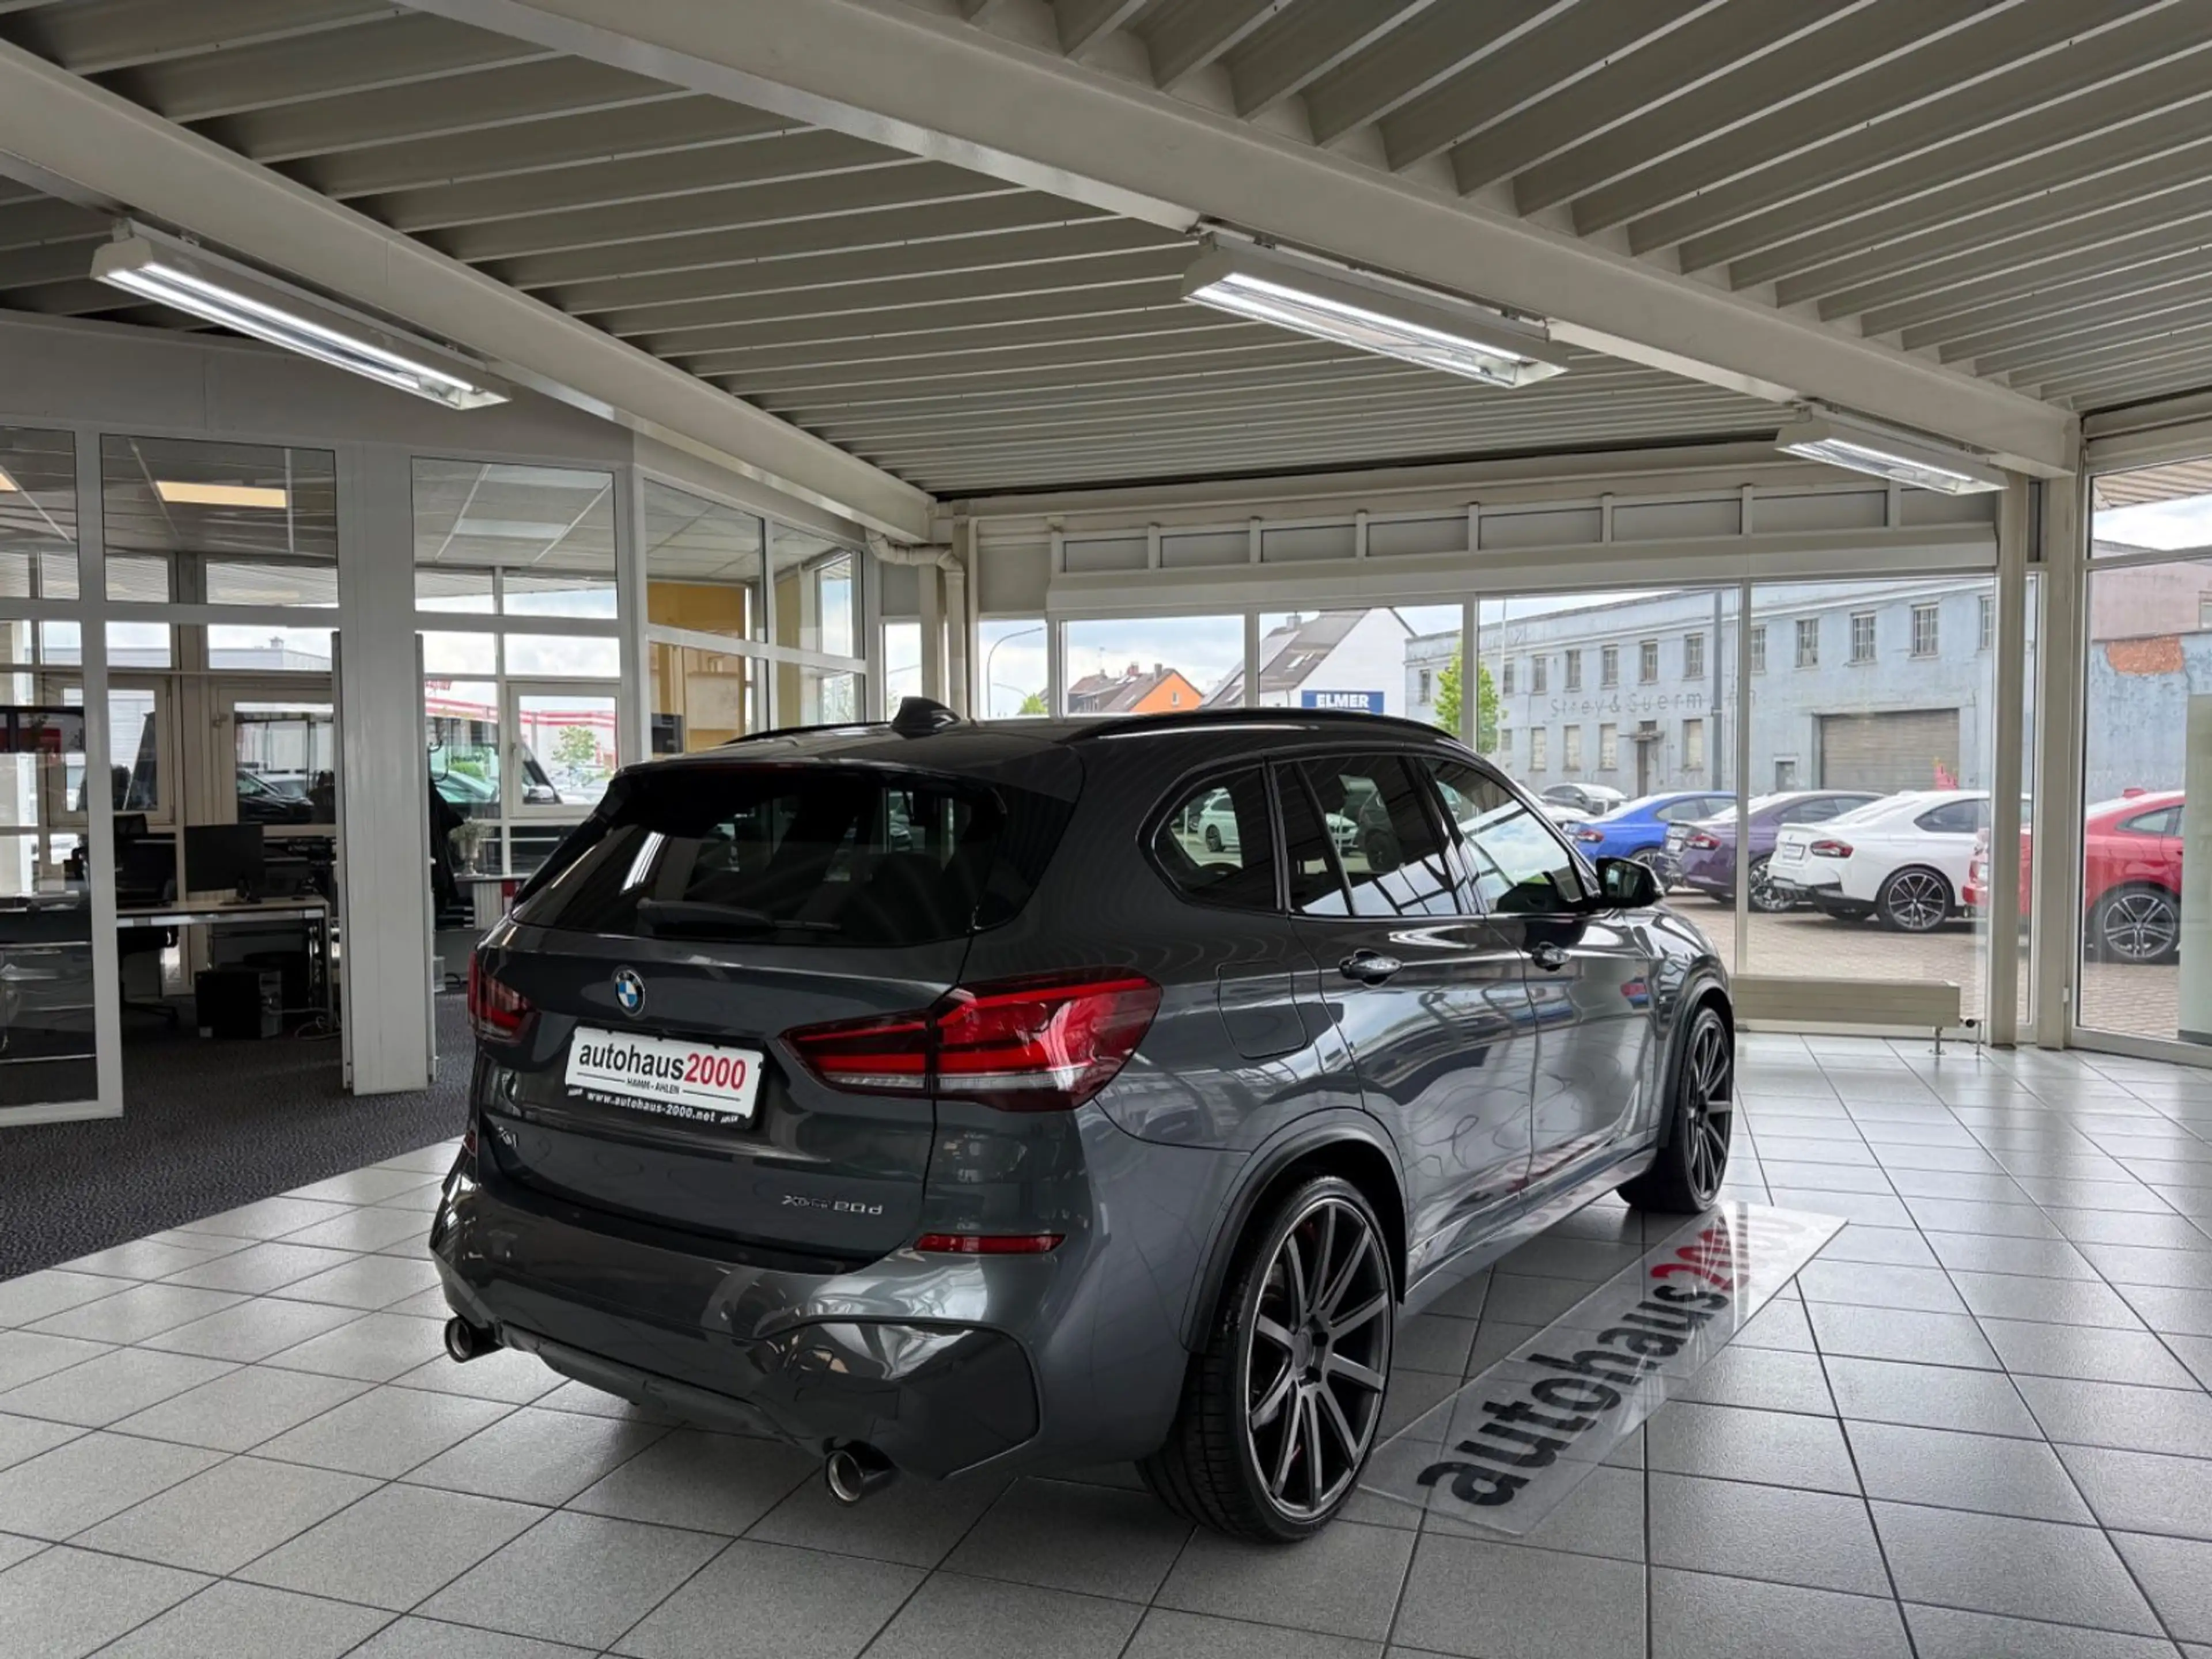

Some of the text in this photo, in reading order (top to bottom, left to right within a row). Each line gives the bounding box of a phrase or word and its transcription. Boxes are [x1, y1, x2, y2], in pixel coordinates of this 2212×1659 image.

[1316, 693, 1370, 709] ELMER
[578, 1043, 747, 1091] autohaus2000
[586, 1092, 715, 1123] www.autohaus-2000.net
